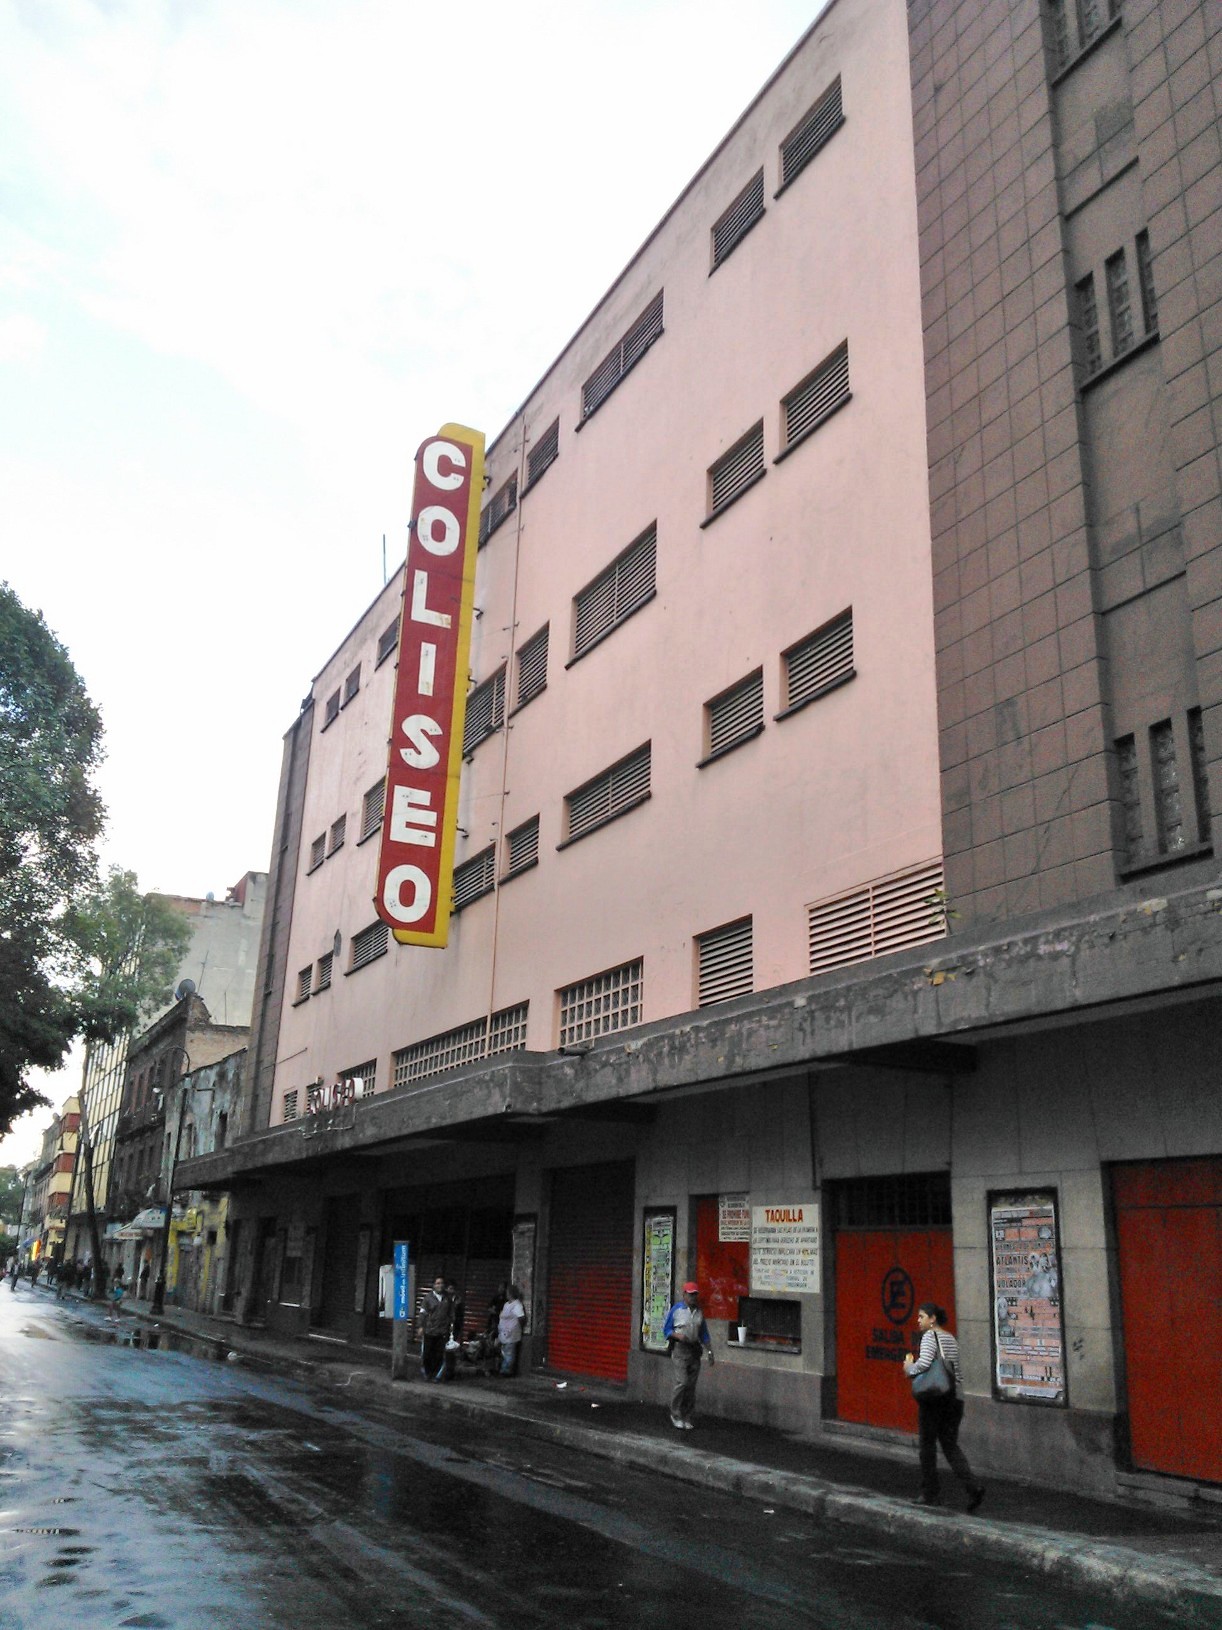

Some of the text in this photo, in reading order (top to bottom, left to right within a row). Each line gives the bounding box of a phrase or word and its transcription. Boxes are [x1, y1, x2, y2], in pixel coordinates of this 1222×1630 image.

[383, 440, 467, 924] COLISEO
[765, 1209, 804, 1223] TAQUILLA
[996, 1255, 1029, 1266] ATLANTIS
